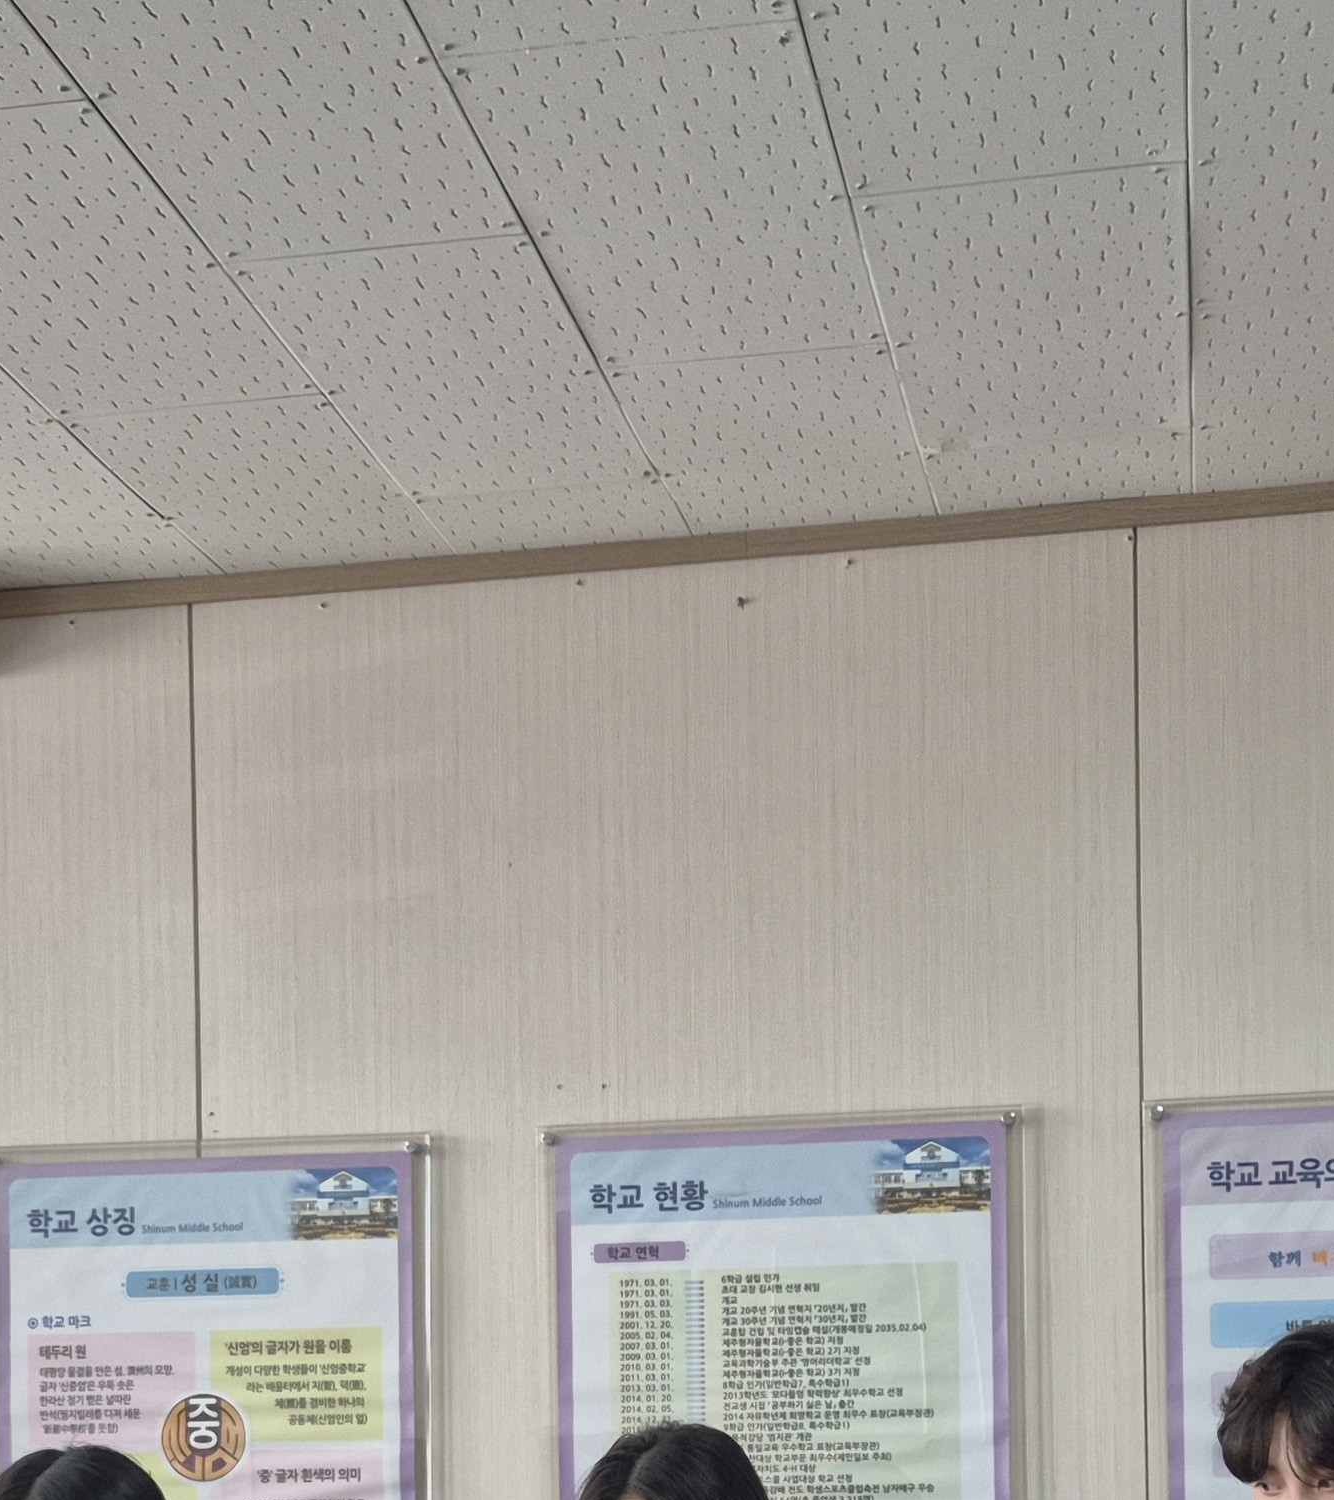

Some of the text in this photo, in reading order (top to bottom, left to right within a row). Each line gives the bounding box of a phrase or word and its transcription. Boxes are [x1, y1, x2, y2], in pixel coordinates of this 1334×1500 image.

[1208, 1161, 1262, 1192] 학교
[590, 1180, 708, 1214] 학교 현황
[713, 1196, 822, 1209] Shinum Middle School
[27, 1206, 135, 1238] 학교 상징
[142, 1222, 243, 1234] Shinum Middle School
[607, 1246, 659, 1260] 학교 연혁
[1268, 1250, 1301, 1268] 함께
[146, 1277, 170, 1291] 교훈
[785, 1284, 801, 1293] 선생
[804, 1283, 820, 1292] 취임
[740, 1306, 766, 1315] 20주년
[770, 1305, 785, 1314] 기념
[42, 1315, 91, 1329] 학교 마크
[39, 1345, 86, 1360] 테두리 원
[265, 1340, 300, 1355] 글자가
[303, 1339, 326, 1354] 원을
[275, 1468, 298, 1483] 글자
[301, 1468, 336, 1483] 흰색의
[338, 1467, 361, 1482] 의미
[800, 1464, 816, 1473] 대상
